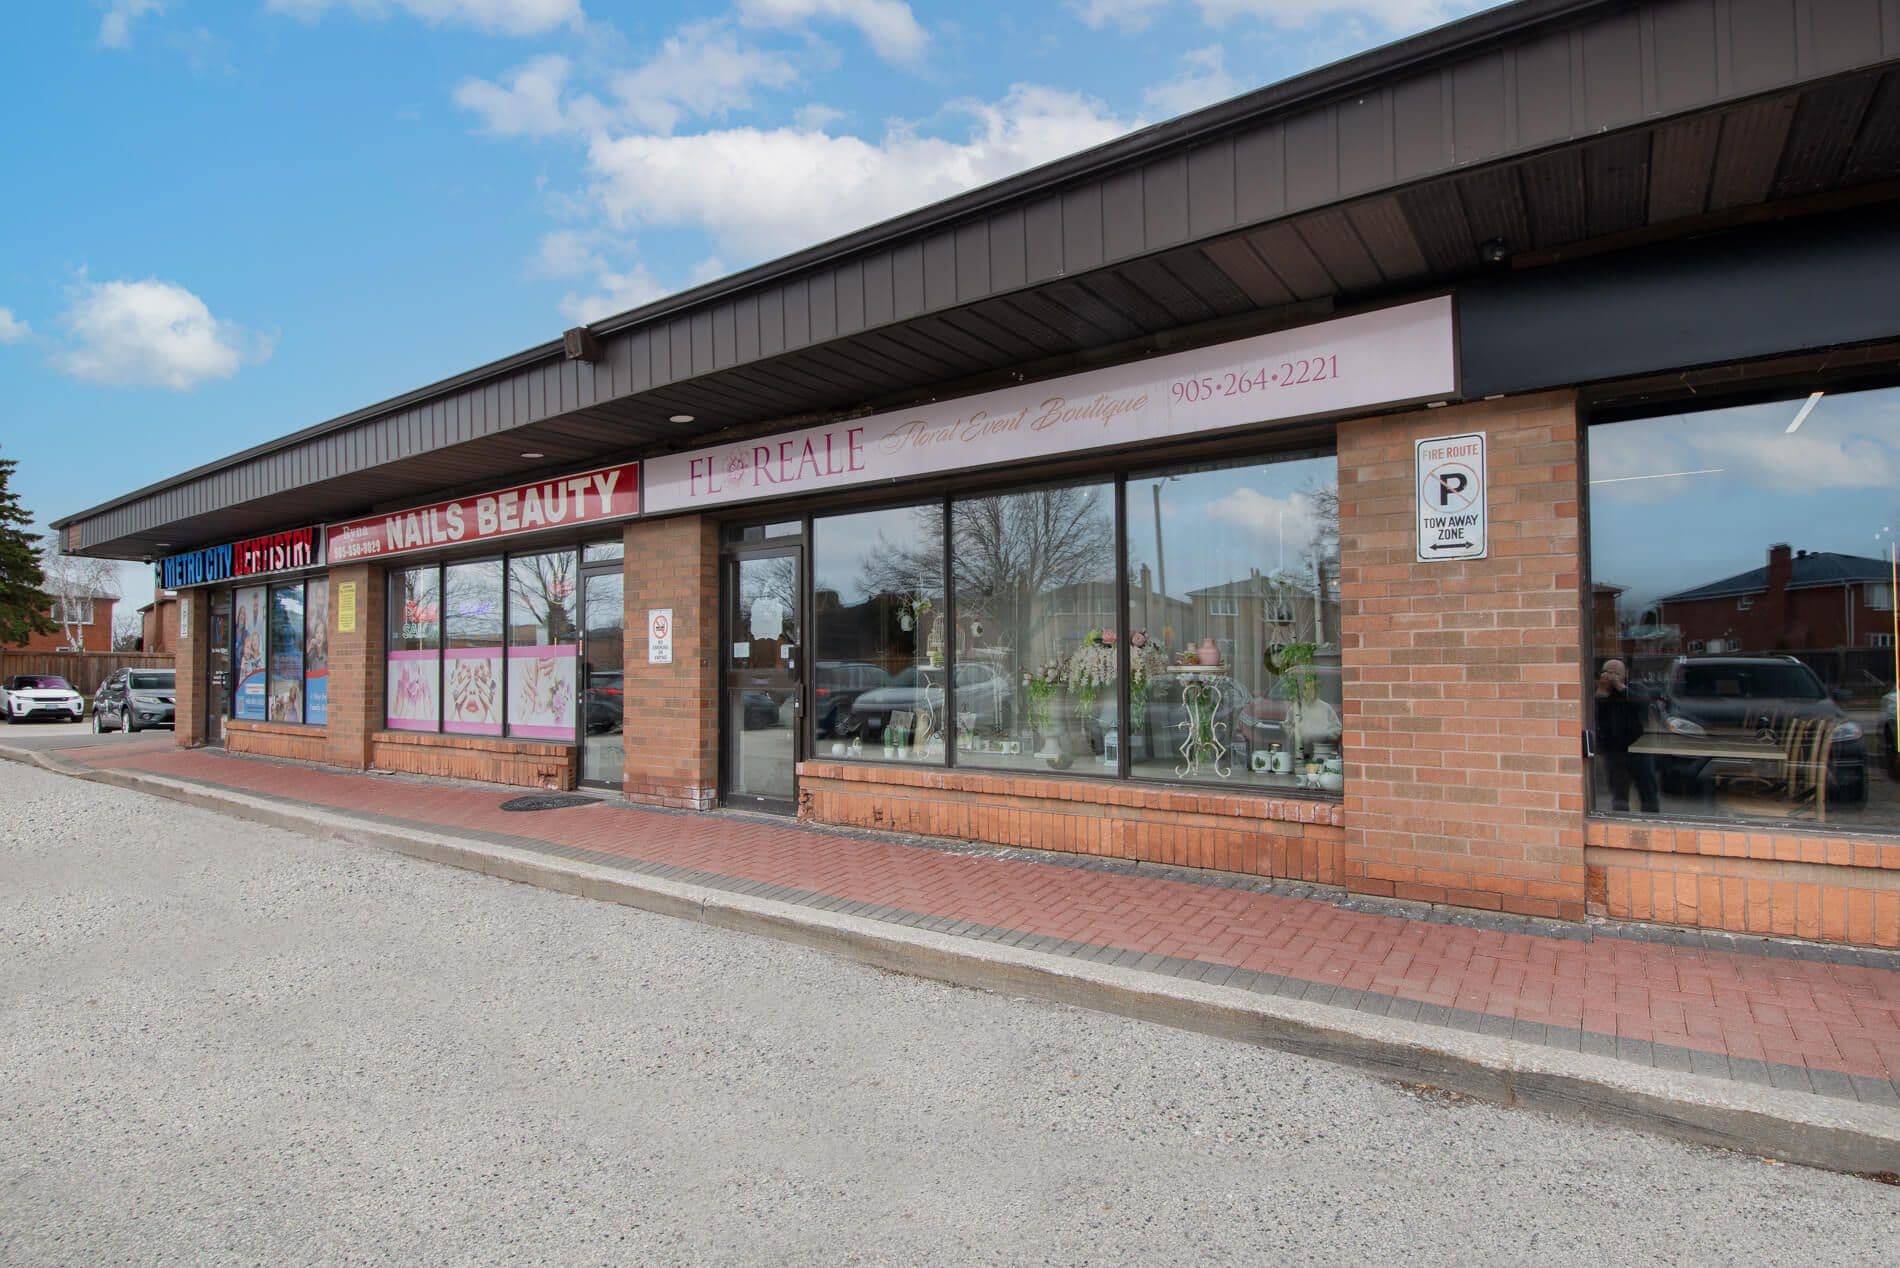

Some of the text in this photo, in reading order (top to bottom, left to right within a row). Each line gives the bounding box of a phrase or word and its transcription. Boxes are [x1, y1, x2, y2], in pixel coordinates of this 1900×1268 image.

[880, 392, 1149, 455] Floral Event Boutique
[1422, 444, 1479, 460] FIRE ROUTE
[1440, 473, 1467, 506] P
[386, 470, 620, 550] NAILS BEAUTY
[1424, 514, 1480, 529] TOW AWAY
[1438, 528, 1465, 540] ZONE
[164, 527, 313, 588] METRO CITY DENTISTRY
